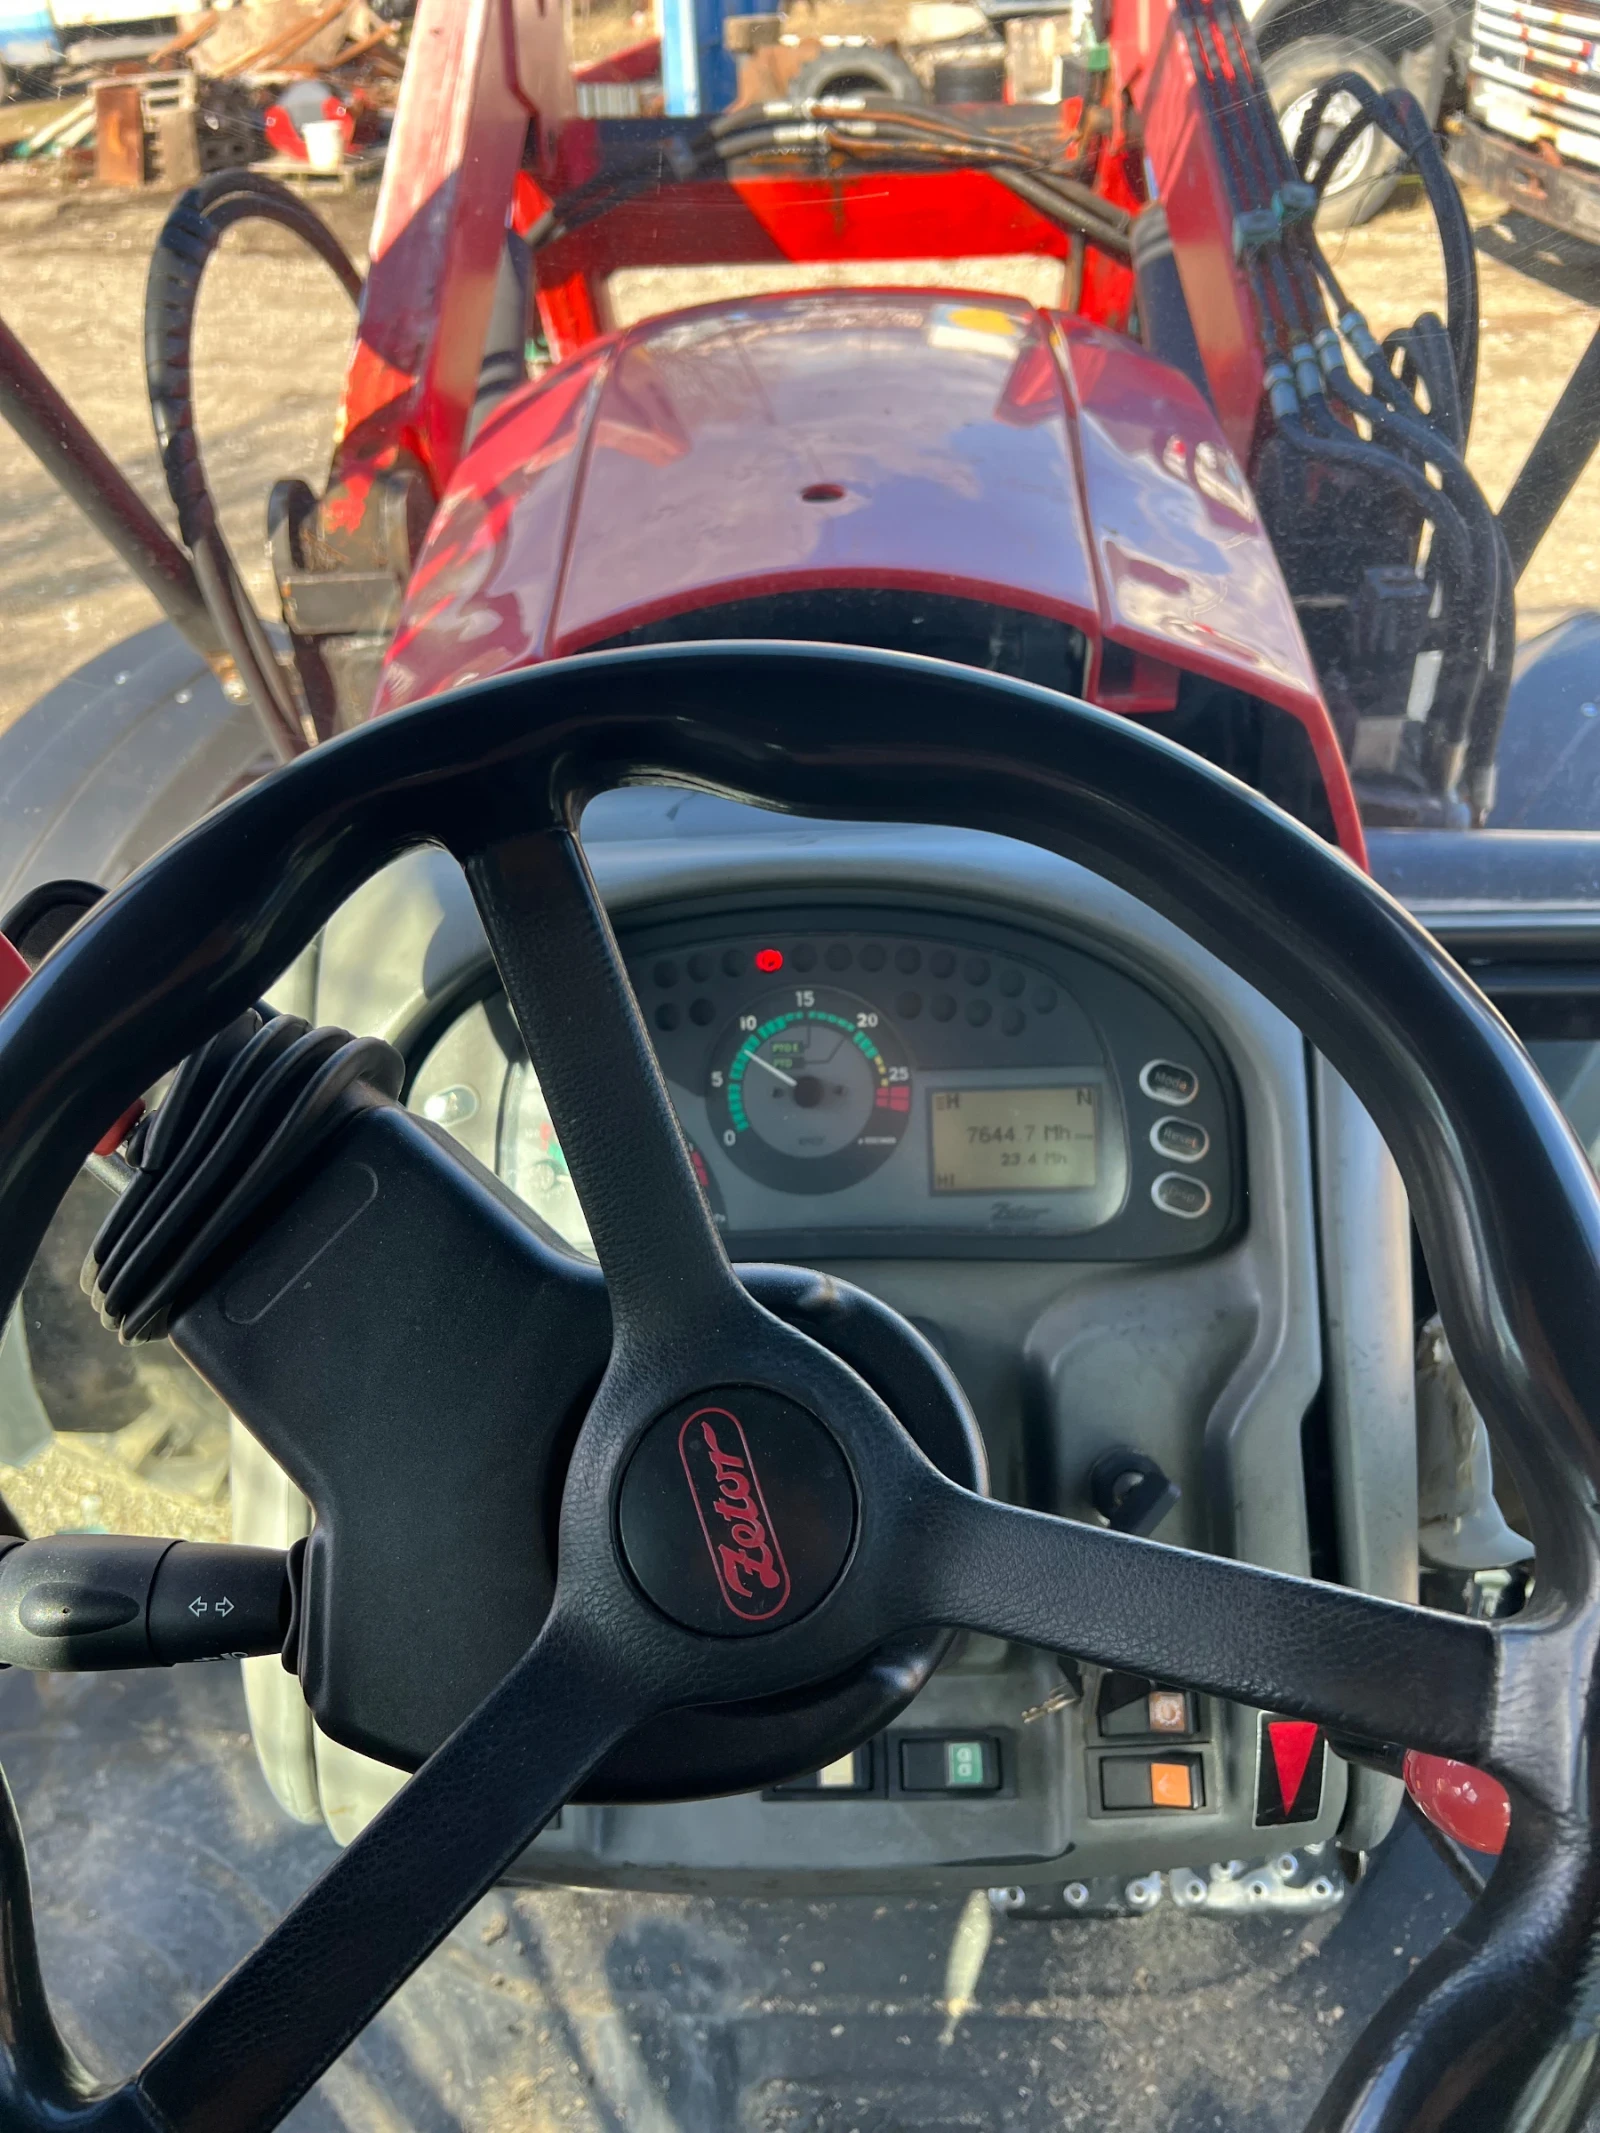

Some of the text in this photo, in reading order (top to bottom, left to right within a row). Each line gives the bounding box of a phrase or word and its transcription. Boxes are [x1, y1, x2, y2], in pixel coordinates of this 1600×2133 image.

[795, 991, 815, 1007] 15
[739, 1015, 757, 1031] 10
[856, 1013, 878, 1028] 20
[711, 1071, 723, 1087] 5
[889, 1067, 910, 1081] 25
[1154, 1071, 1187, 1093] Mode
[1076, 1088, 1093, 1106] N
[723, 1130, 736, 1146] 0
[967, 1124, 1071, 1144] 7644.7 Mh
[1163, 1126, 1197, 1149] Reset
[701, 1421, 781, 1598] Zetor
